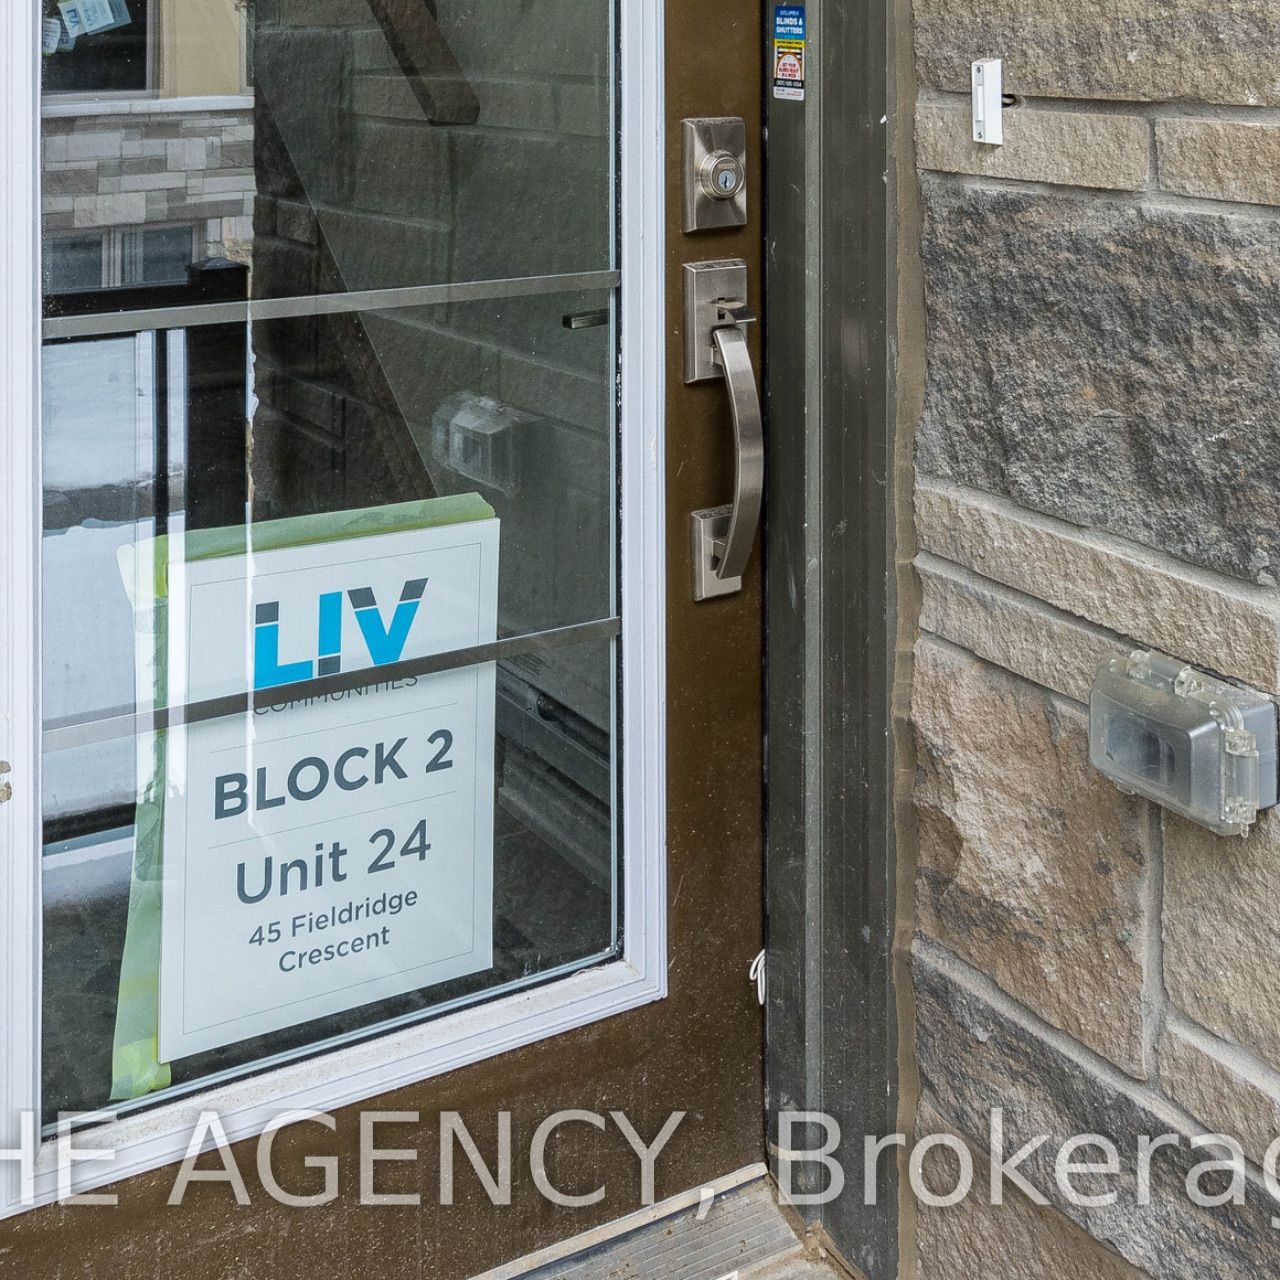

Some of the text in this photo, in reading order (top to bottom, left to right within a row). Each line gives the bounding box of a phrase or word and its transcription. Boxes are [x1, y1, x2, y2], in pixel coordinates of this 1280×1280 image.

[254, 577, 428, 690] LIV
[214, 729, 454, 821] BLOCK 2
[237, 819, 432, 906] Unit 24
[248, 887, 418, 948] 45 Fieldridge
[279, 925, 390, 974] Crescent
